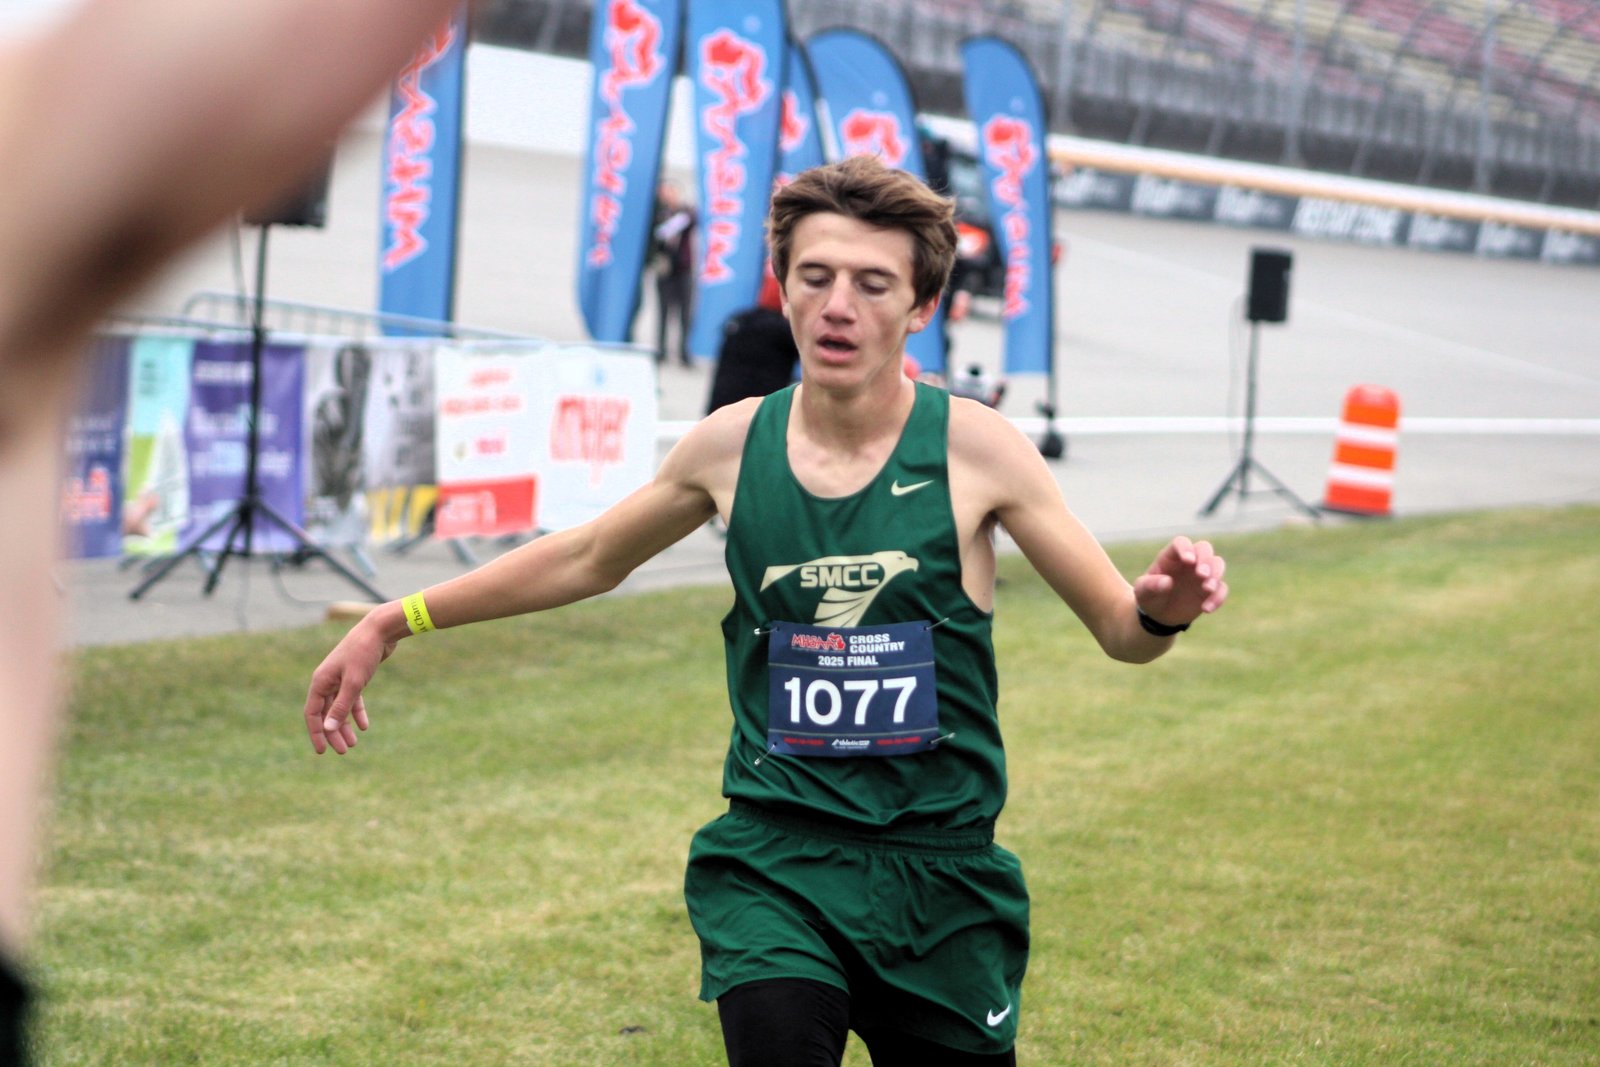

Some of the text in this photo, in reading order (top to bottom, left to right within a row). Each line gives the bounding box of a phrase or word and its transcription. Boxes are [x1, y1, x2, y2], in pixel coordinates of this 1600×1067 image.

[800, 564, 880, 588] SMCC
[791, 633, 891, 651] MHSAA CROSS
[849, 641, 905, 654] COUNTRY
[818, 655, 879, 666] 2025 FINAL
[784, 676, 918, 726] 1077
